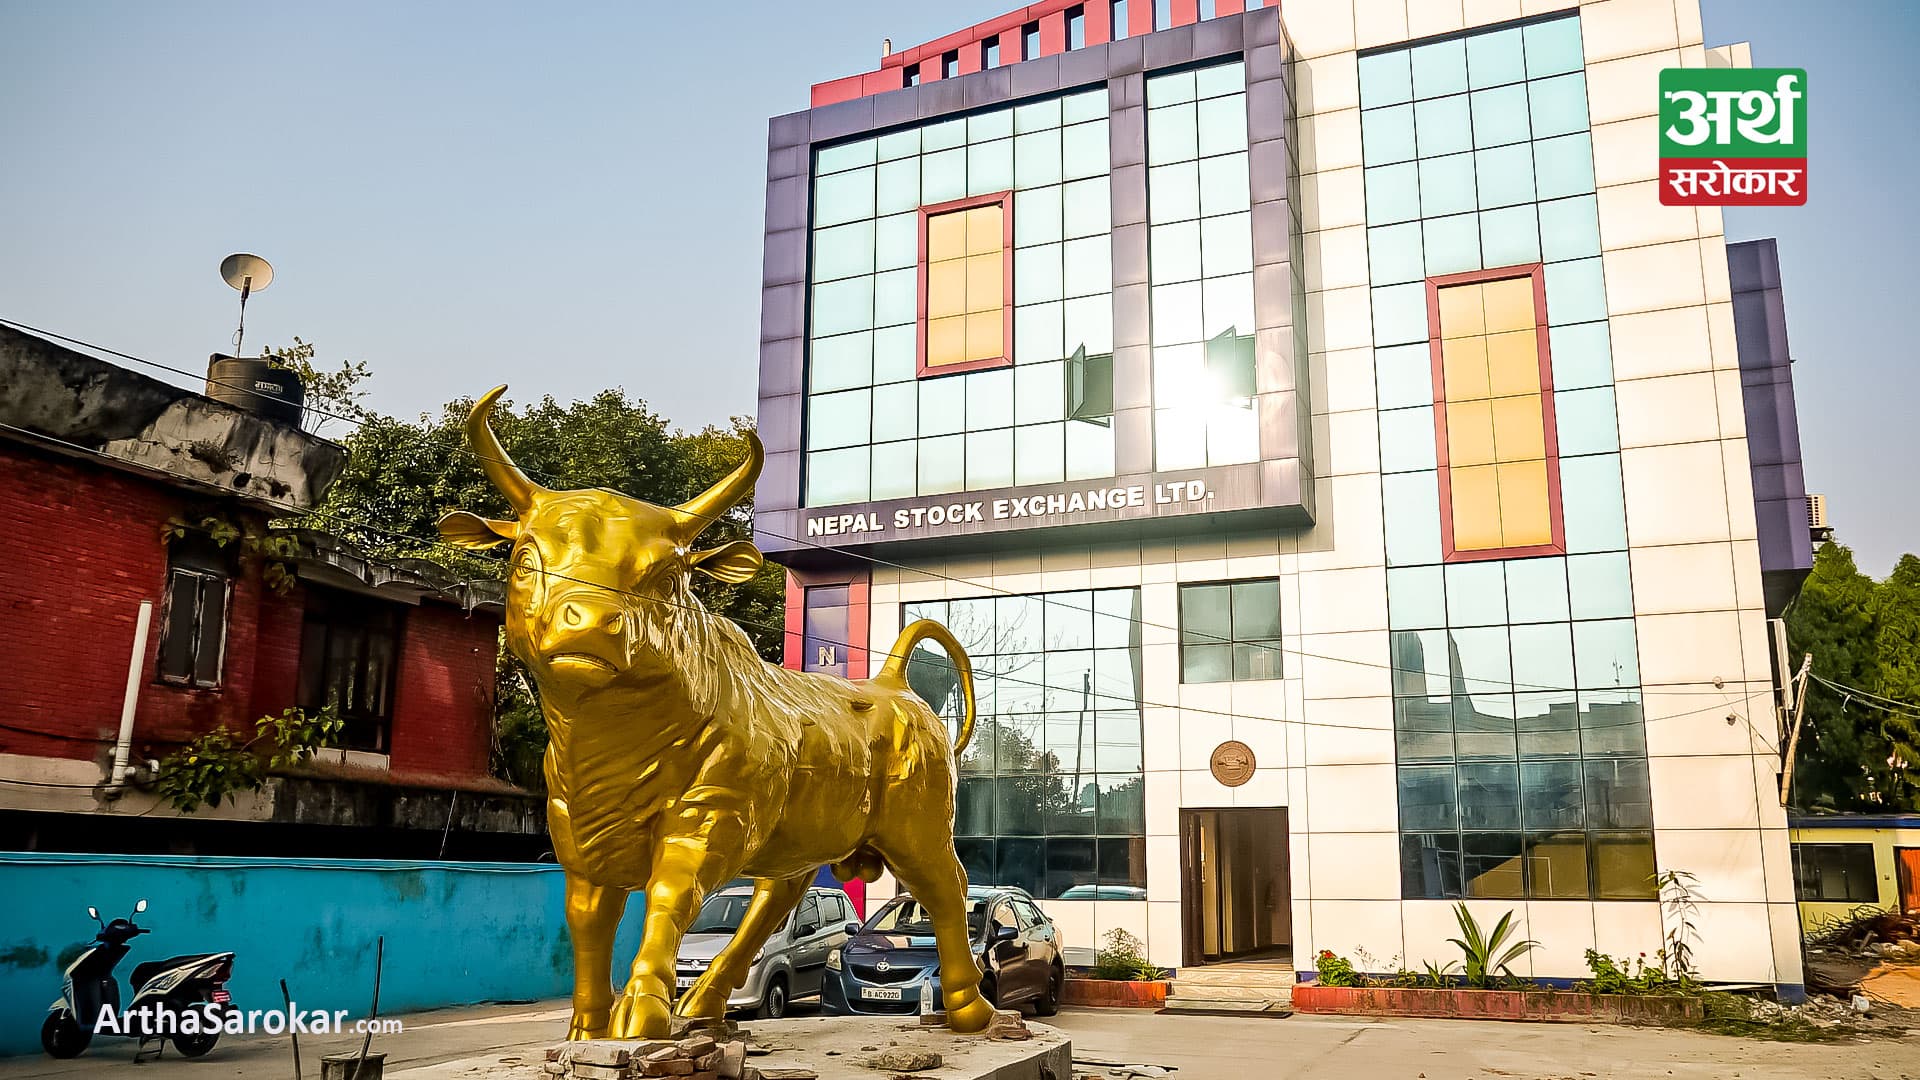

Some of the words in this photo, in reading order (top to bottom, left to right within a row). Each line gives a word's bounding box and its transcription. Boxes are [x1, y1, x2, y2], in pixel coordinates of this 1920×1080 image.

[807, 512, 884, 537] NEPAL
[893, 502, 984, 529] STOCK
[993, 485, 1145, 520] EXCHANGE
[1154, 480, 1214, 505] LTD.
